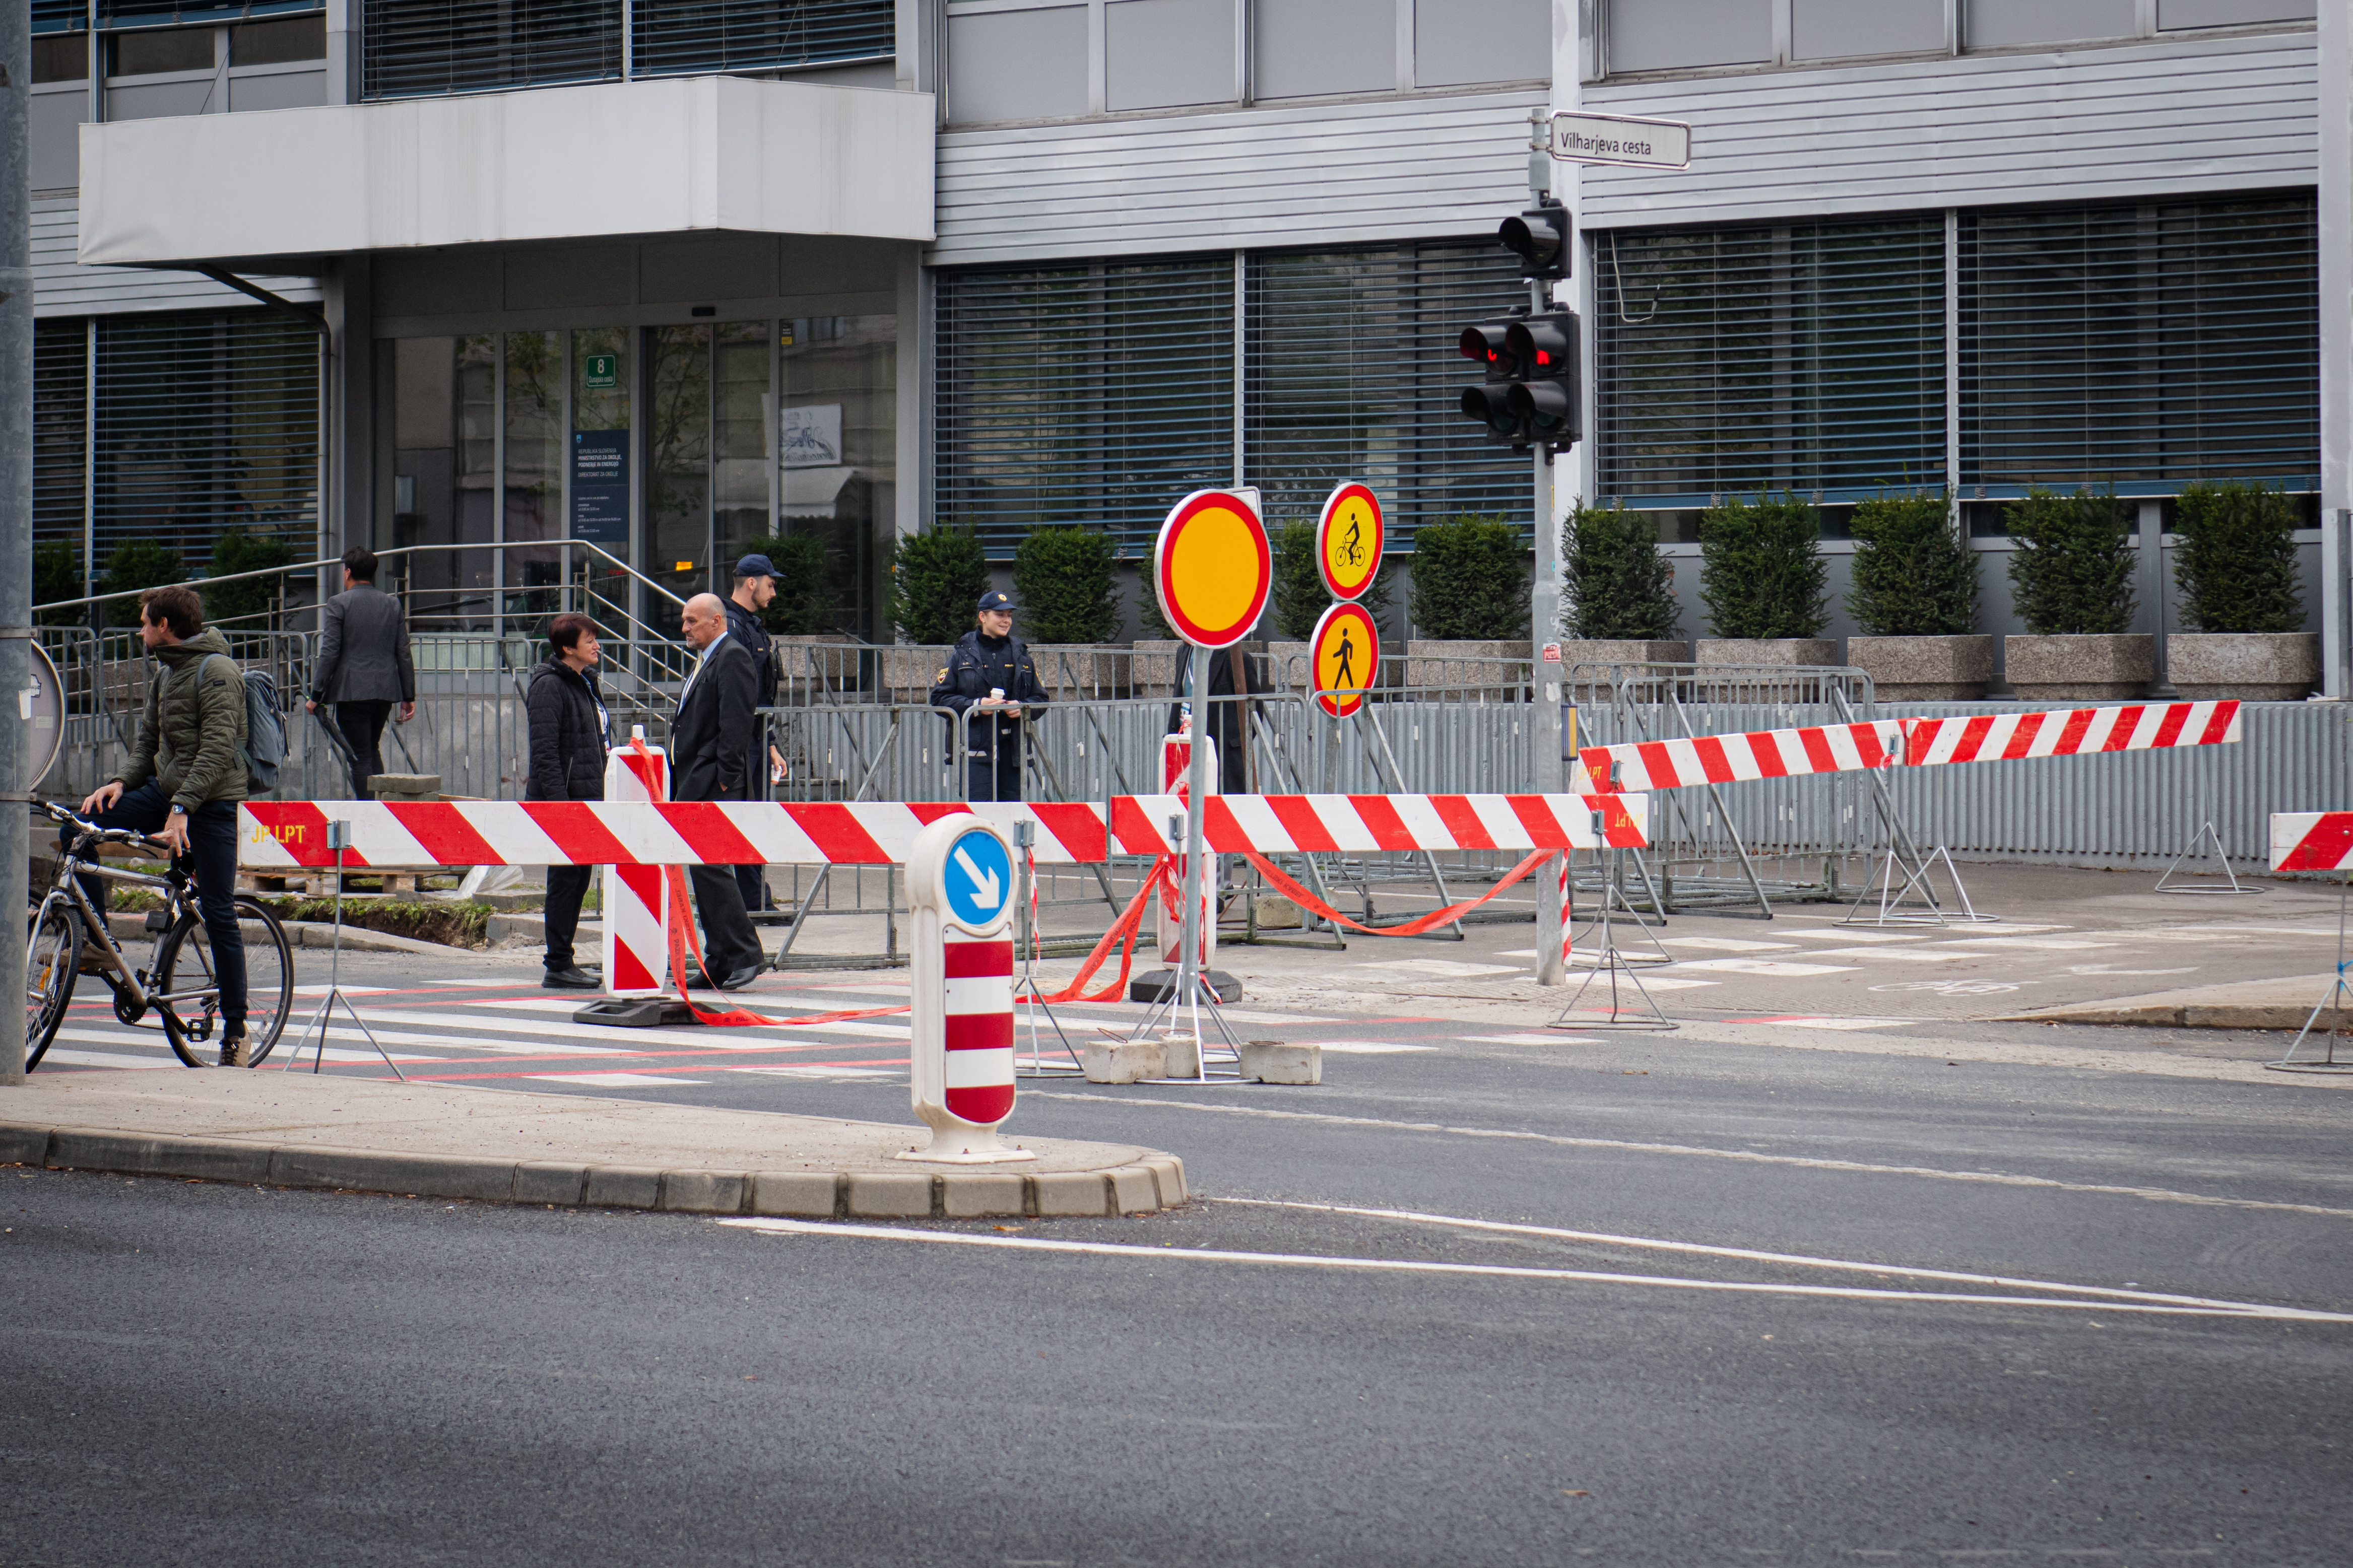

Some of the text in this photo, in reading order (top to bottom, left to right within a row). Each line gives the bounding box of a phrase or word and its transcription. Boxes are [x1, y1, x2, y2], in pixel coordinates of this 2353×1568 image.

[1561, 132, 1651, 155] Vilharjeva cesta
[598, 359, 605, 374] 8
[589, 376, 604, 384] Dunajska
[1579, 766, 1602, 780] JP LPT
[1615, 812, 1630, 827] LPT
[251, 825, 305, 843] JP LPT
